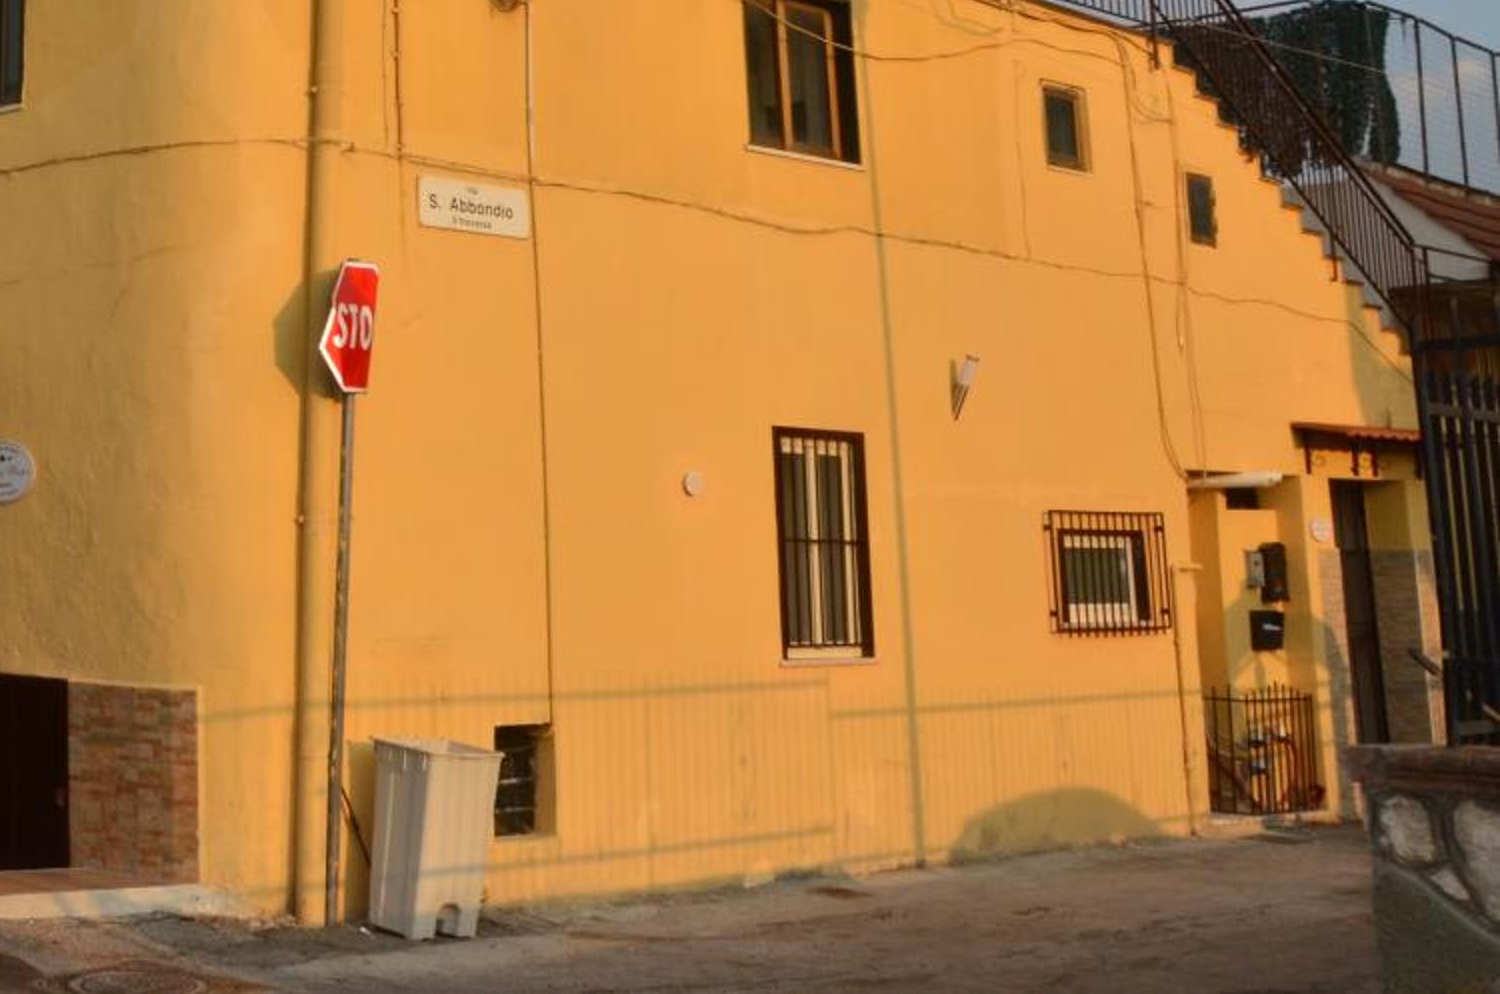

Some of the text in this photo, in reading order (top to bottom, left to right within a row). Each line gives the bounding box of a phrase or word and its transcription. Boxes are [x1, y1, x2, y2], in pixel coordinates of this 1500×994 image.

[429, 193, 514, 220] S. Abbondio
[333, 302, 373, 350] STO
